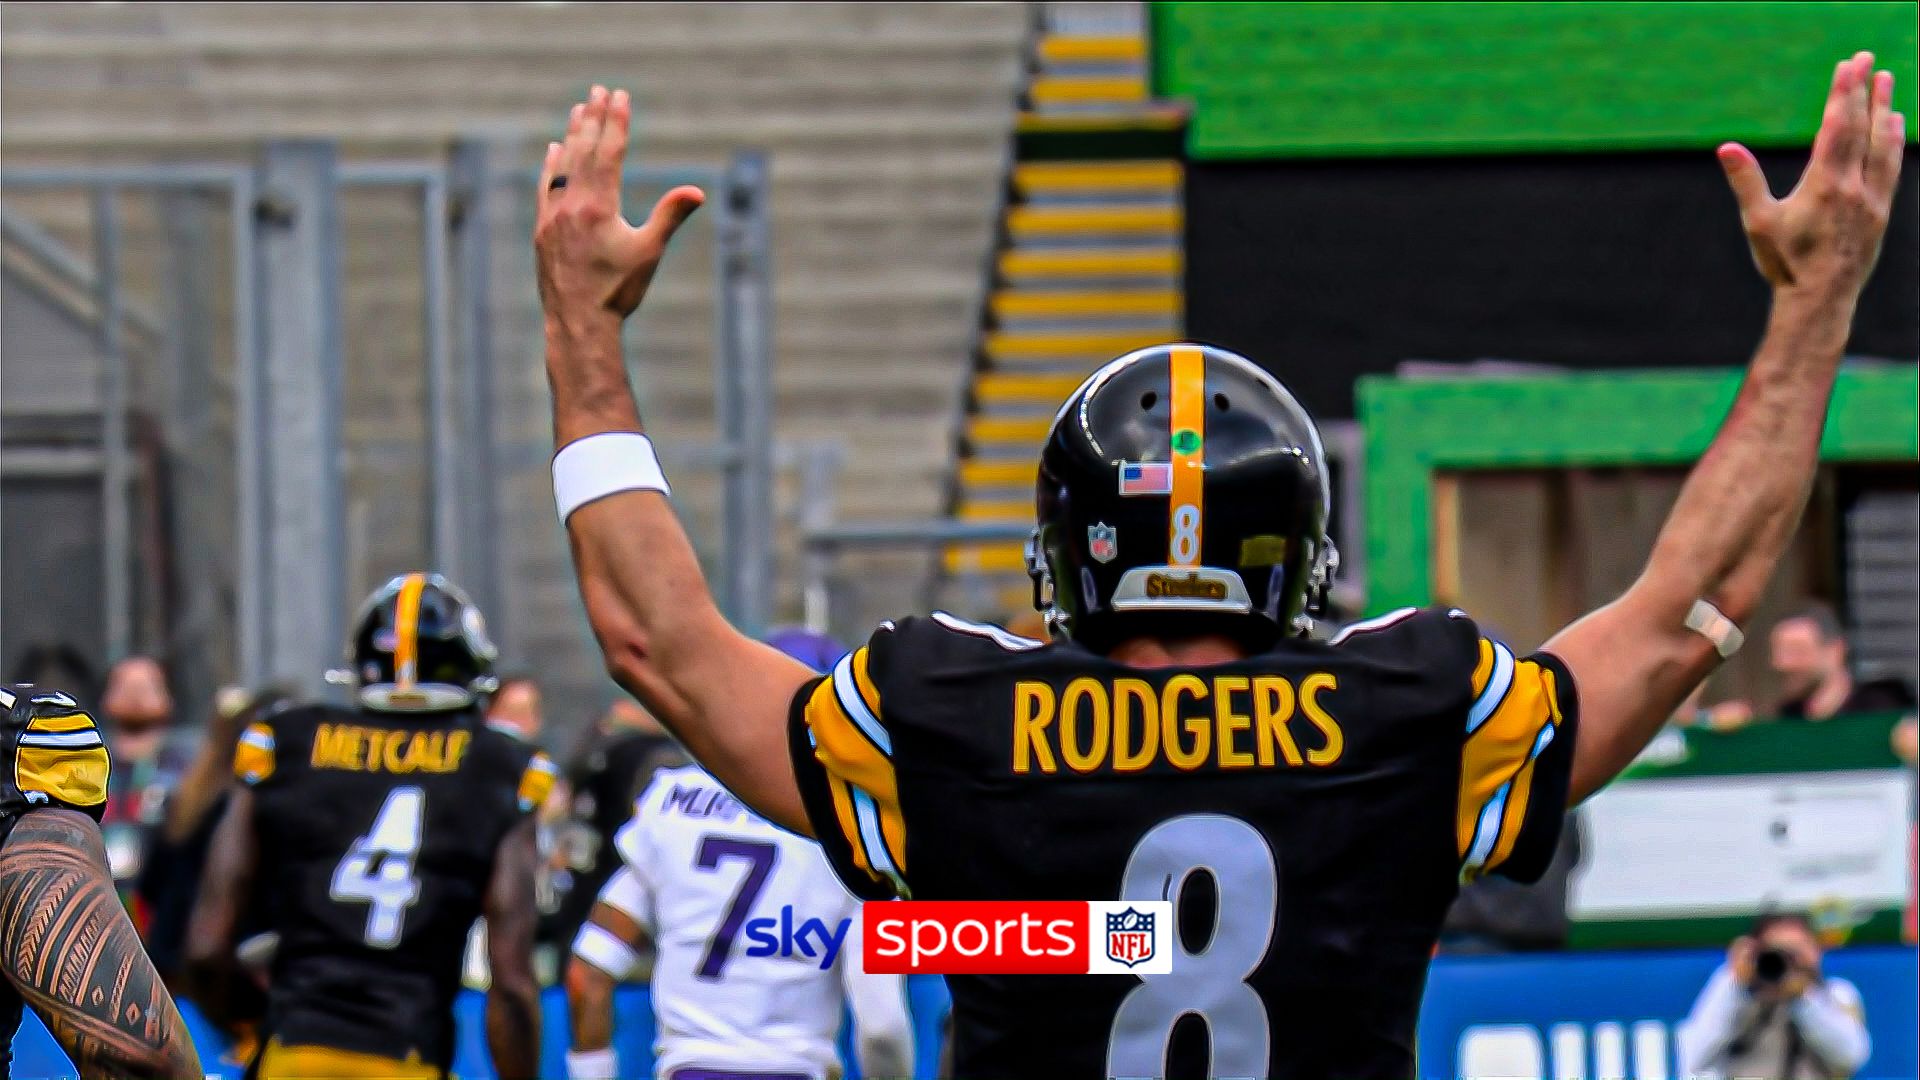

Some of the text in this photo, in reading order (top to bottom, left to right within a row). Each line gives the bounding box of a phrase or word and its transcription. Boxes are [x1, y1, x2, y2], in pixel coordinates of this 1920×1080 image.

[1170, 505, 1200, 564] 8
[311, 722, 474, 775] METCALF
[1012, 672, 1345, 773] RODGERS
[329, 785, 426, 949] 4
[696, 834, 779, 980] 7
[1105, 813, 1278, 1080] 8
